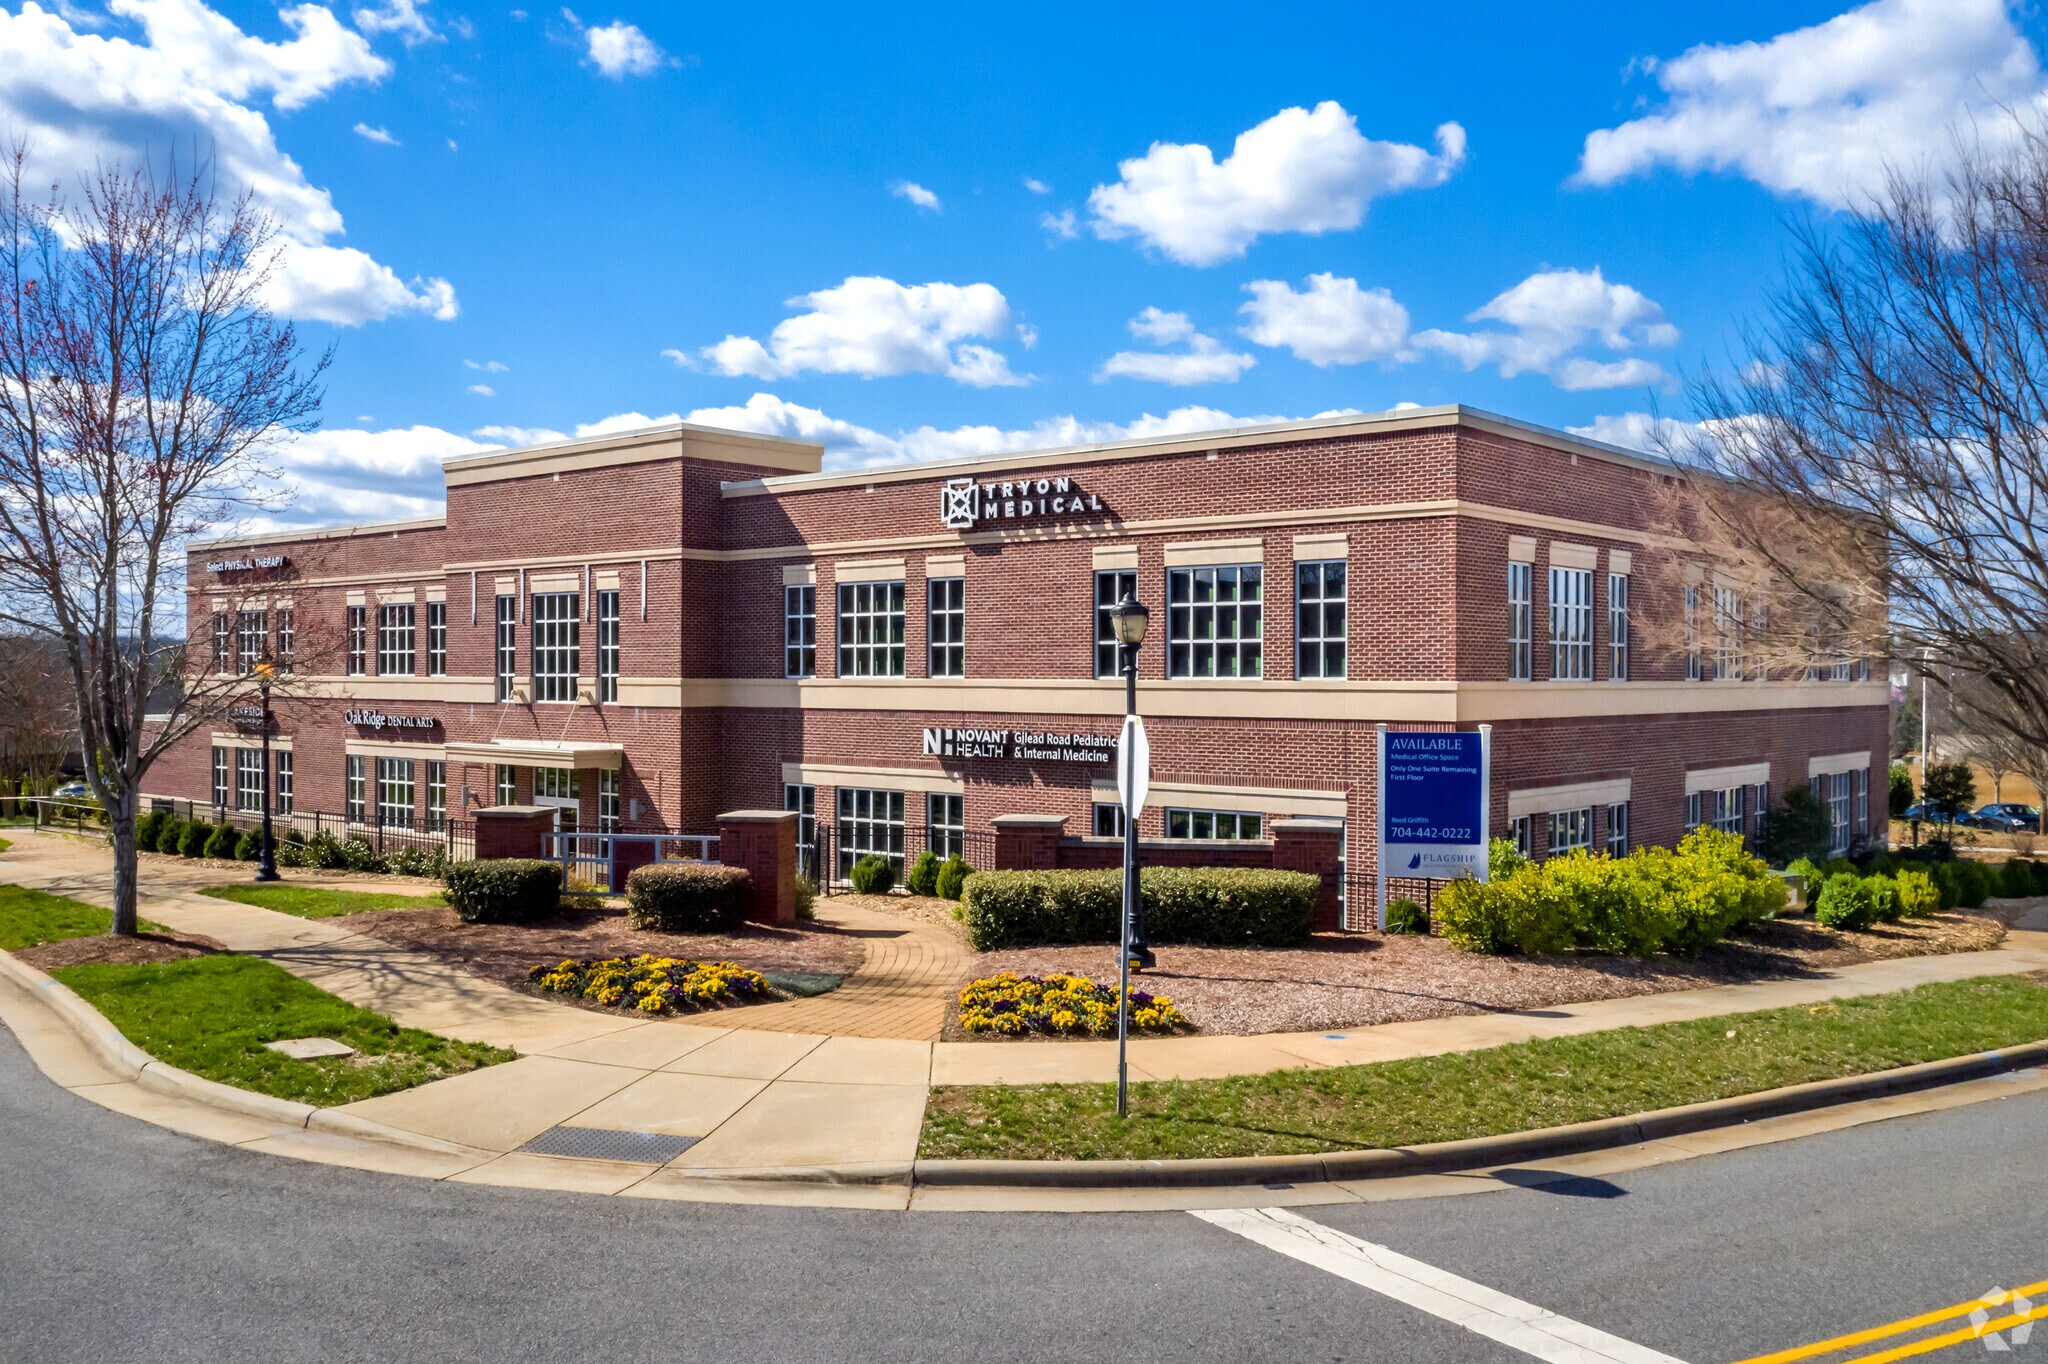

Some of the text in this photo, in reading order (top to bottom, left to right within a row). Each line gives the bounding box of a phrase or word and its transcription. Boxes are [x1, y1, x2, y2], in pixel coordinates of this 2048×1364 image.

[986, 477, 1069, 499] TRYON
[985, 495, 1102, 519] MEDICAL
[207, 562, 224, 572] Select
[345, 709, 434, 729] Oak Ridge DENTAL ARTS
[956, 729, 1009, 744] NOVANT
[1014, 731, 1045, 746] Gilead
[1046, 733, 1071, 746] Road
[956, 742, 1004, 758] HEALTH
[1391, 738, 1463, 751] AVAILABLE
[1014, 746, 1109, 763] & Internal Medicine
[1391, 753, 1460, 762] Medical Office Space
[1390, 765, 1477, 775] Only One Suite Remaining
[1391, 827, 1471, 839] 704-442-0222
[1423, 853, 1476, 863] FLAGSHIP
